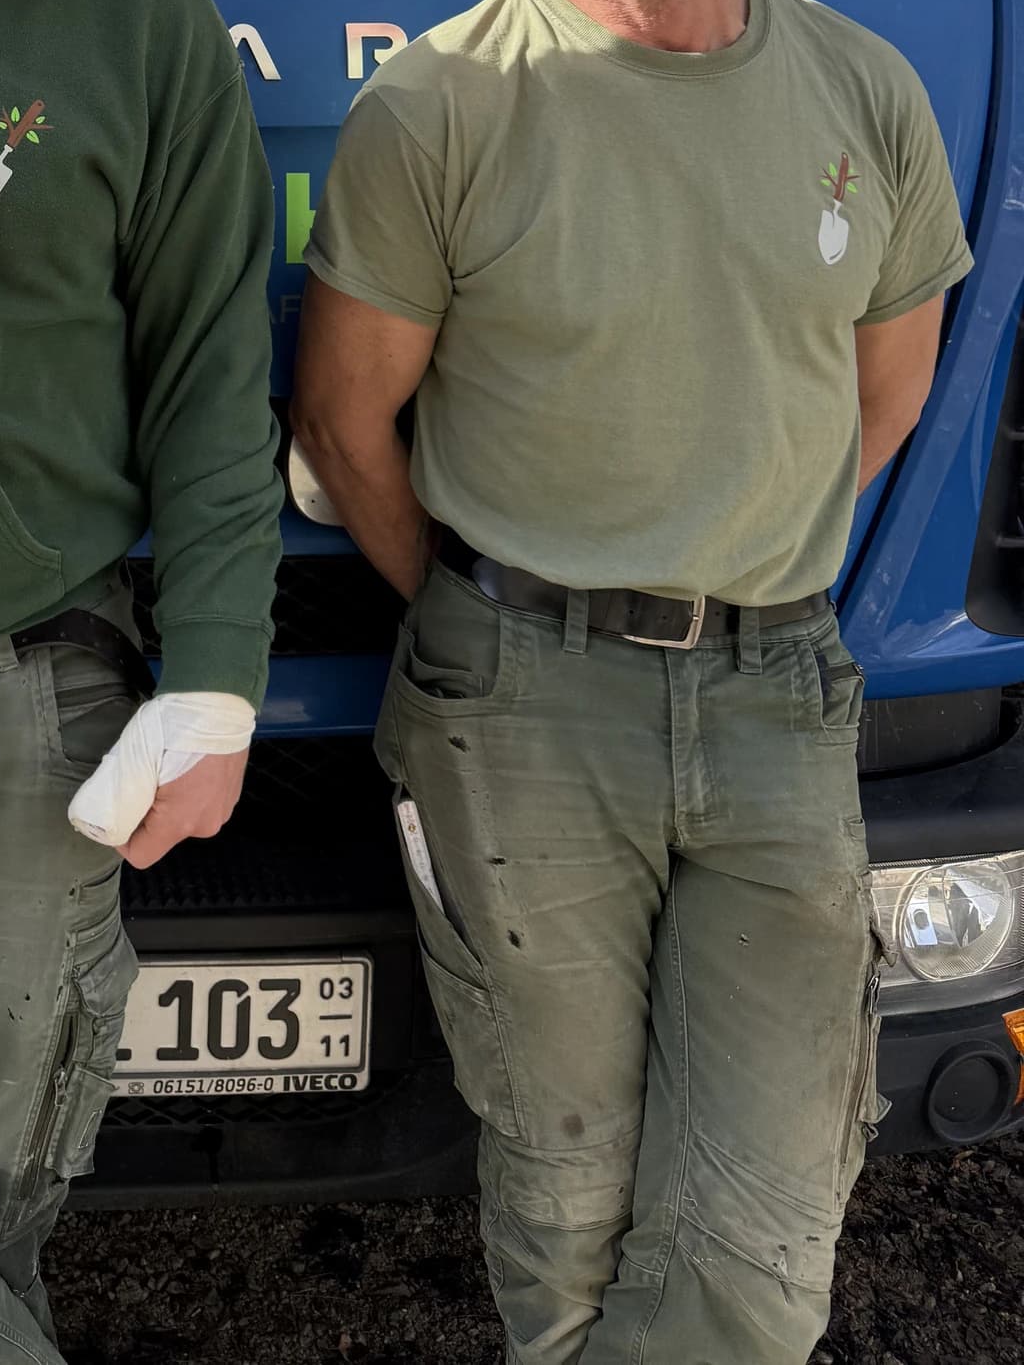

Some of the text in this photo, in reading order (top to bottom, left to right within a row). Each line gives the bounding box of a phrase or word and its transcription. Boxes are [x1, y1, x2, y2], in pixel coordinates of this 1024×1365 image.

[319, 977, 353, 1000] 03
[156, 979, 301, 1061] 103
[320, 1035, 350, 1058] 11
[282, 1074, 357, 1091] IVECO
